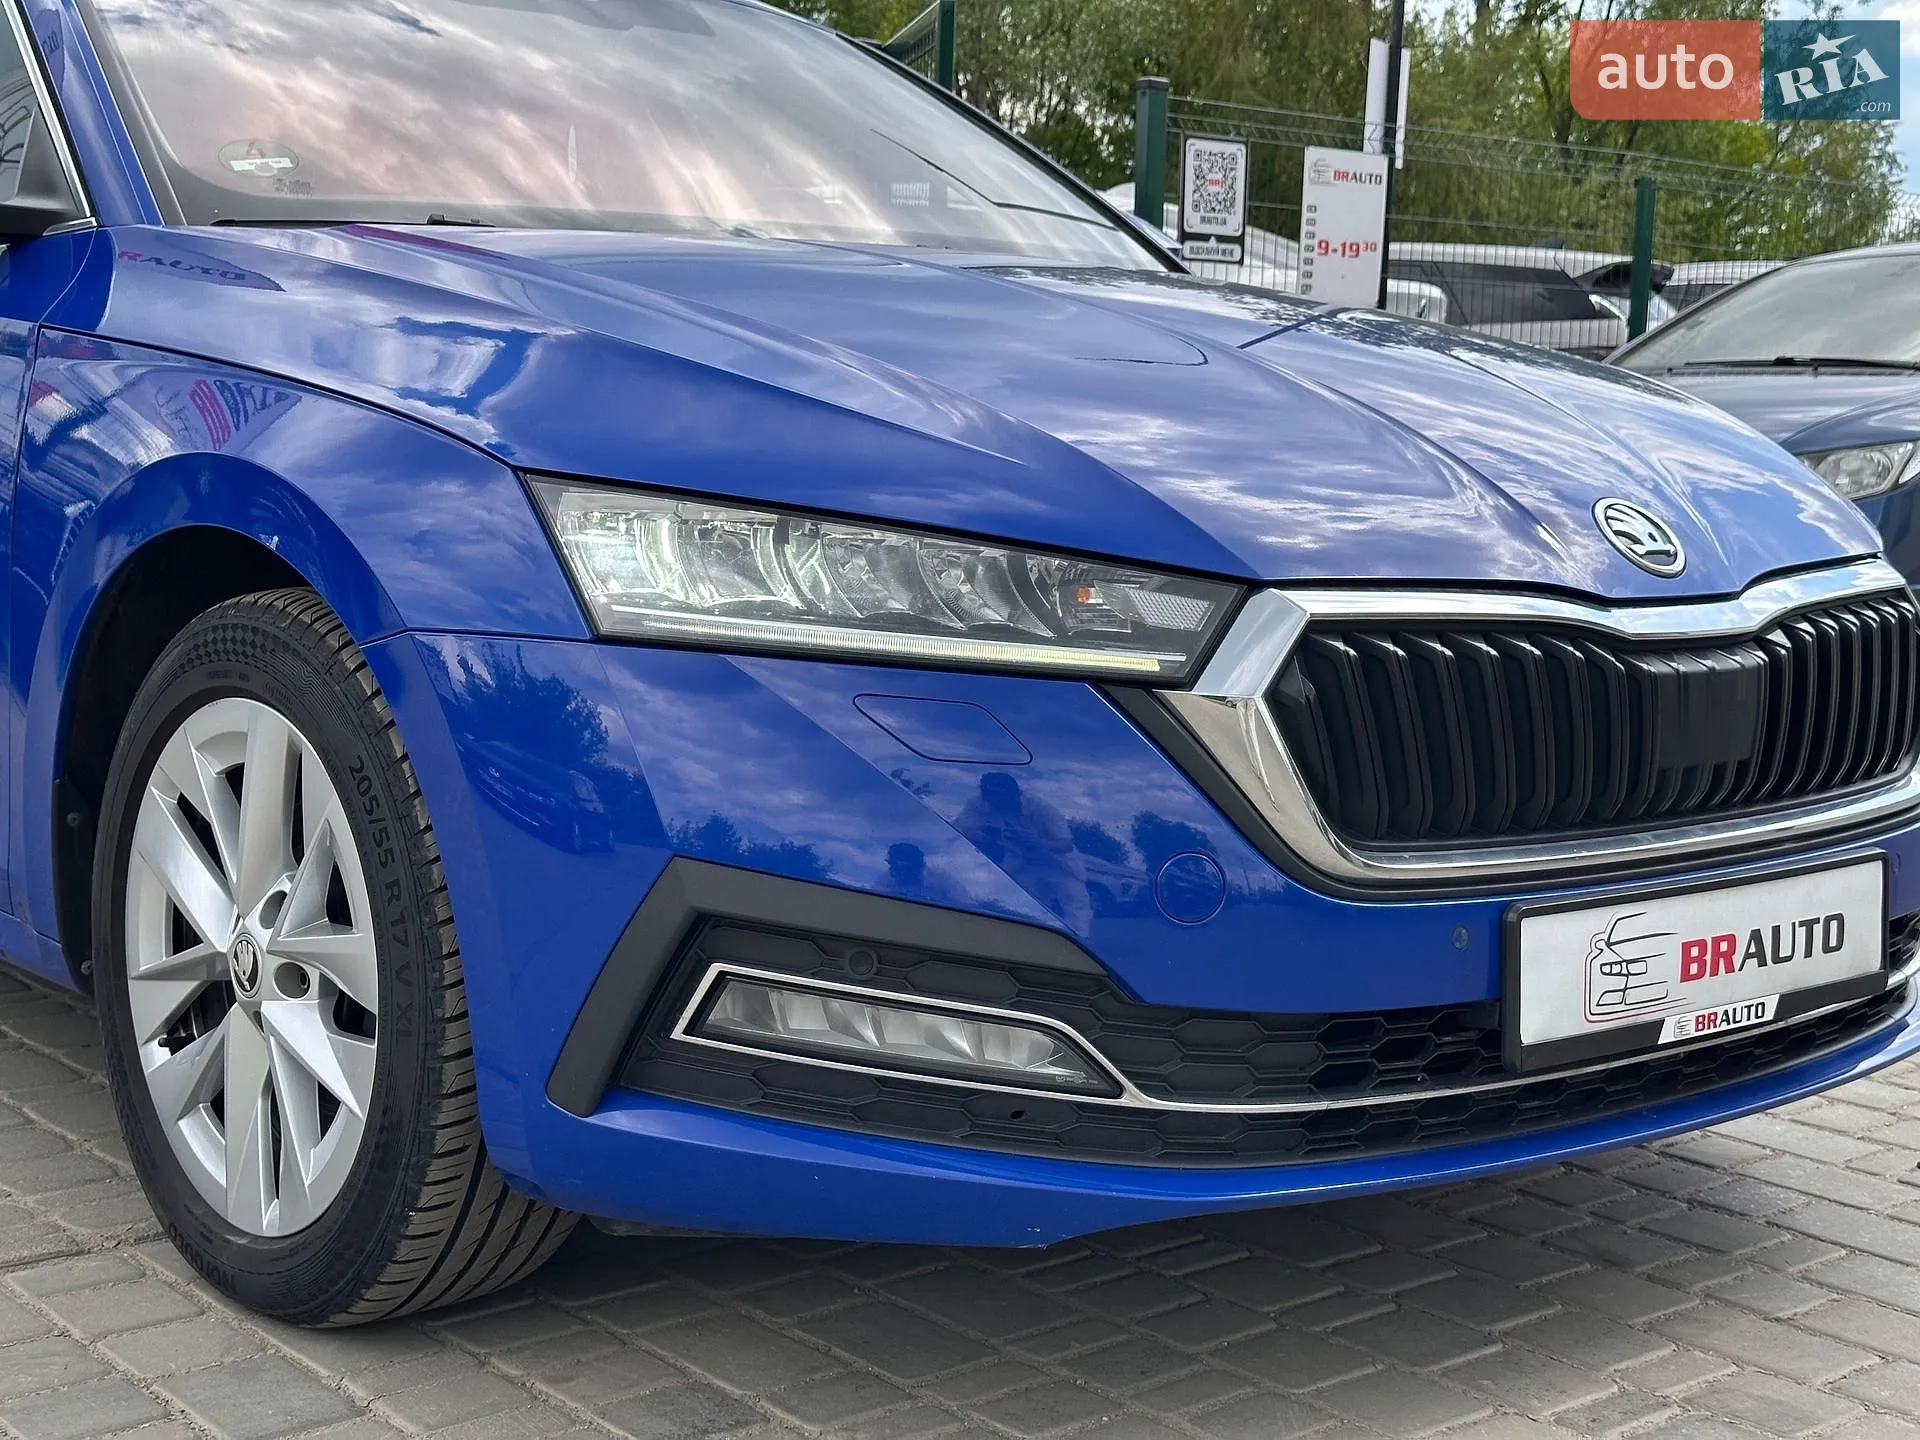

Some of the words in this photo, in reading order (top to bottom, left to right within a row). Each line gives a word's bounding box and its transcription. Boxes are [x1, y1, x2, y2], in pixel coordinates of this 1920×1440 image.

[1333, 170, 1383, 186] BRAUTO
[348, 755, 395, 870] 205/55
[1680, 912, 1845, 984] BRAUTO
[1694, 1001, 1766, 1033] BRAUTO
